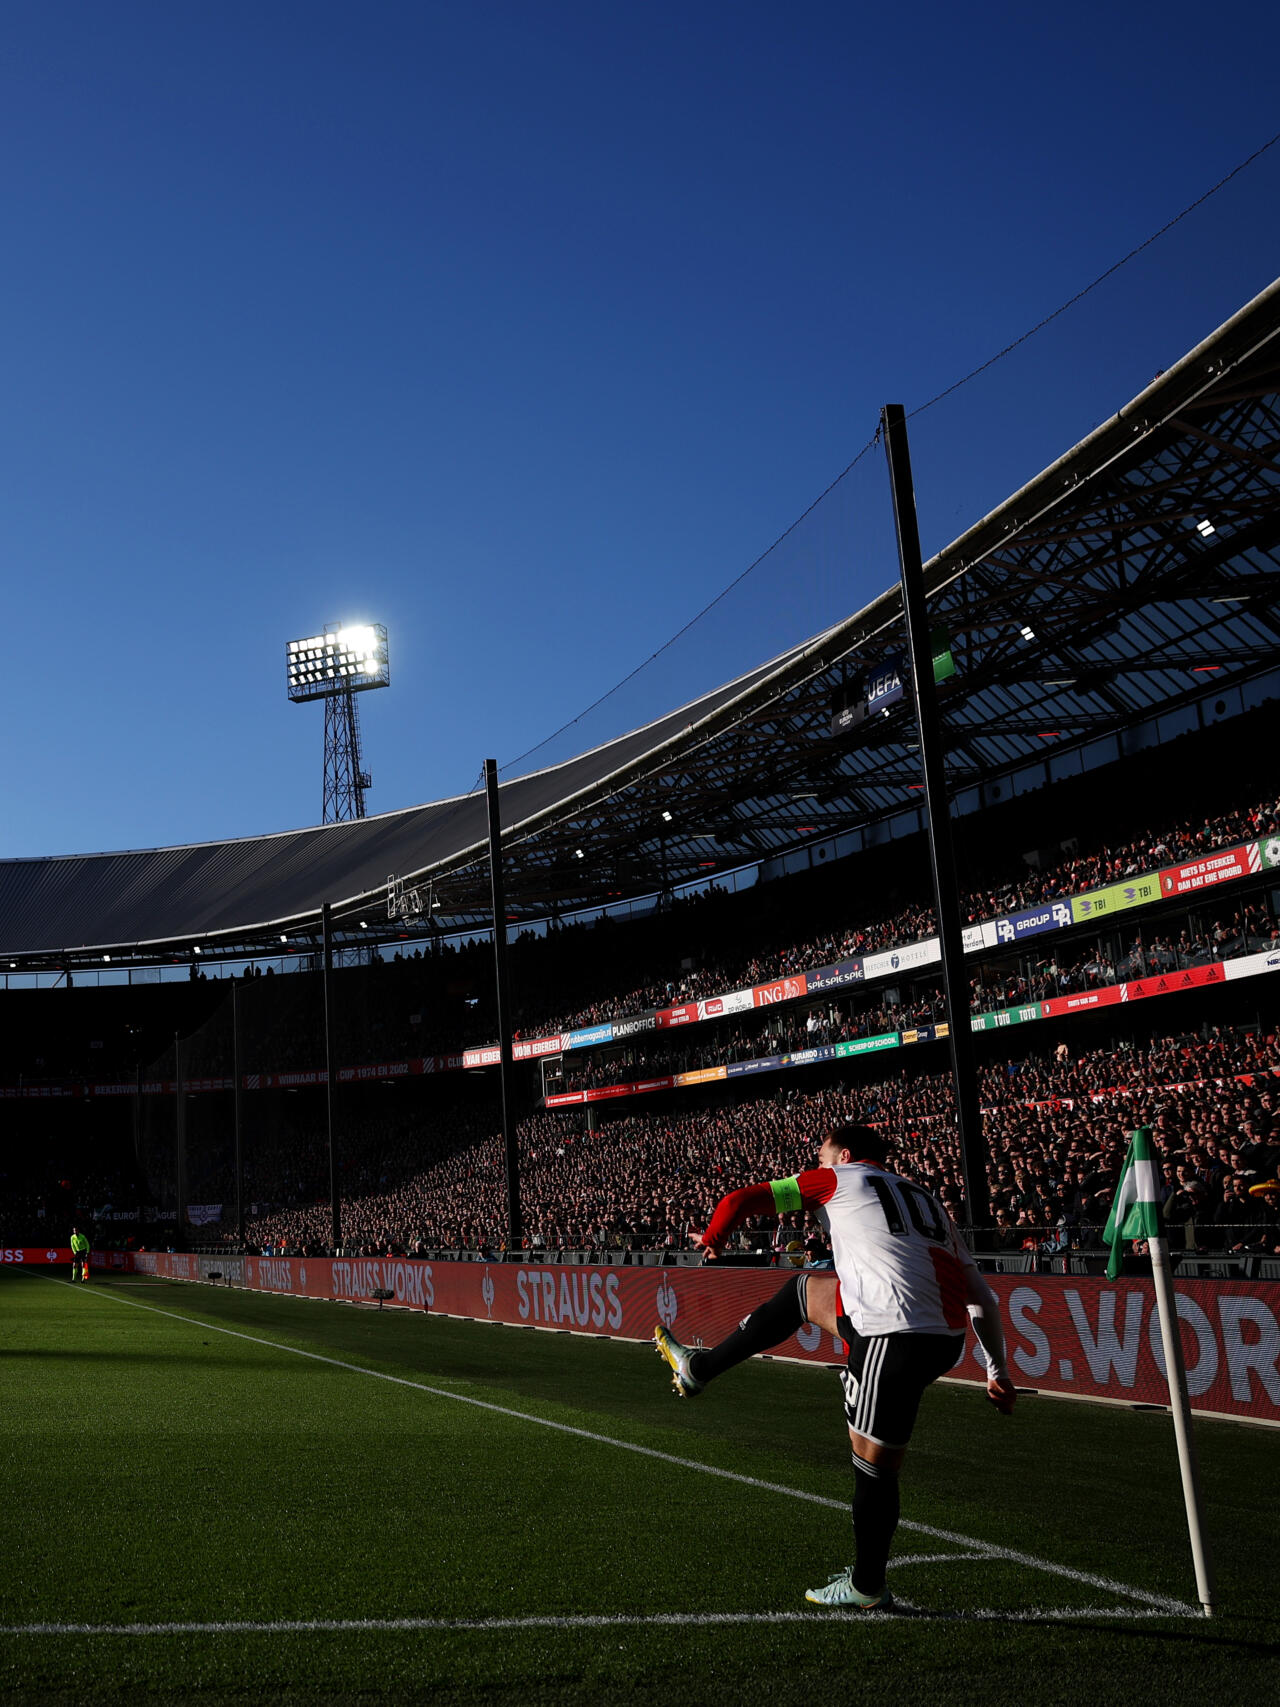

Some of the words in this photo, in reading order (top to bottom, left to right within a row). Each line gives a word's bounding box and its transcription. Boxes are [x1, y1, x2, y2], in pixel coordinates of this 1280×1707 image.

[868, 669, 901, 701] UEFA
[1180, 865, 1198, 878] NIETS
[1199, 863, 1206, 873] IS
[1206, 854, 1235, 870] STERKER
[1177, 880, 1191, 891] DAN
[1192, 876, 1204, 888] DAT
[1218, 864, 1242, 879] WOORD
[1138, 885, 1152, 898] TBI
[1094, 898, 1106, 911] TBI
[1016, 914, 1050, 931] GROUP
[807, 980, 824, 991] SPIE
[825, 975, 844, 986] SPIE
[844, 969, 863, 981] SPIE
[758, 986, 783, 1006] ING
[994, 1013, 1010, 1027] TOTO
[1019, 1007, 1037, 1022] TOTO
[612, 1017, 655, 1036] PLAN@OFFICE
[466, 1053, 480, 1065] VAN
[481, 1050, 501, 1063] IEDER
[514, 1043, 531, 1058] VOOR
[866, 1176, 948, 1247] 10
[258, 1260, 291, 1290] STRAUSS
[332, 1261, 380, 1297] STRAUSS
[382, 1262, 434, 1306] WORKS
[516, 1270, 623, 1330] STRAUSS
